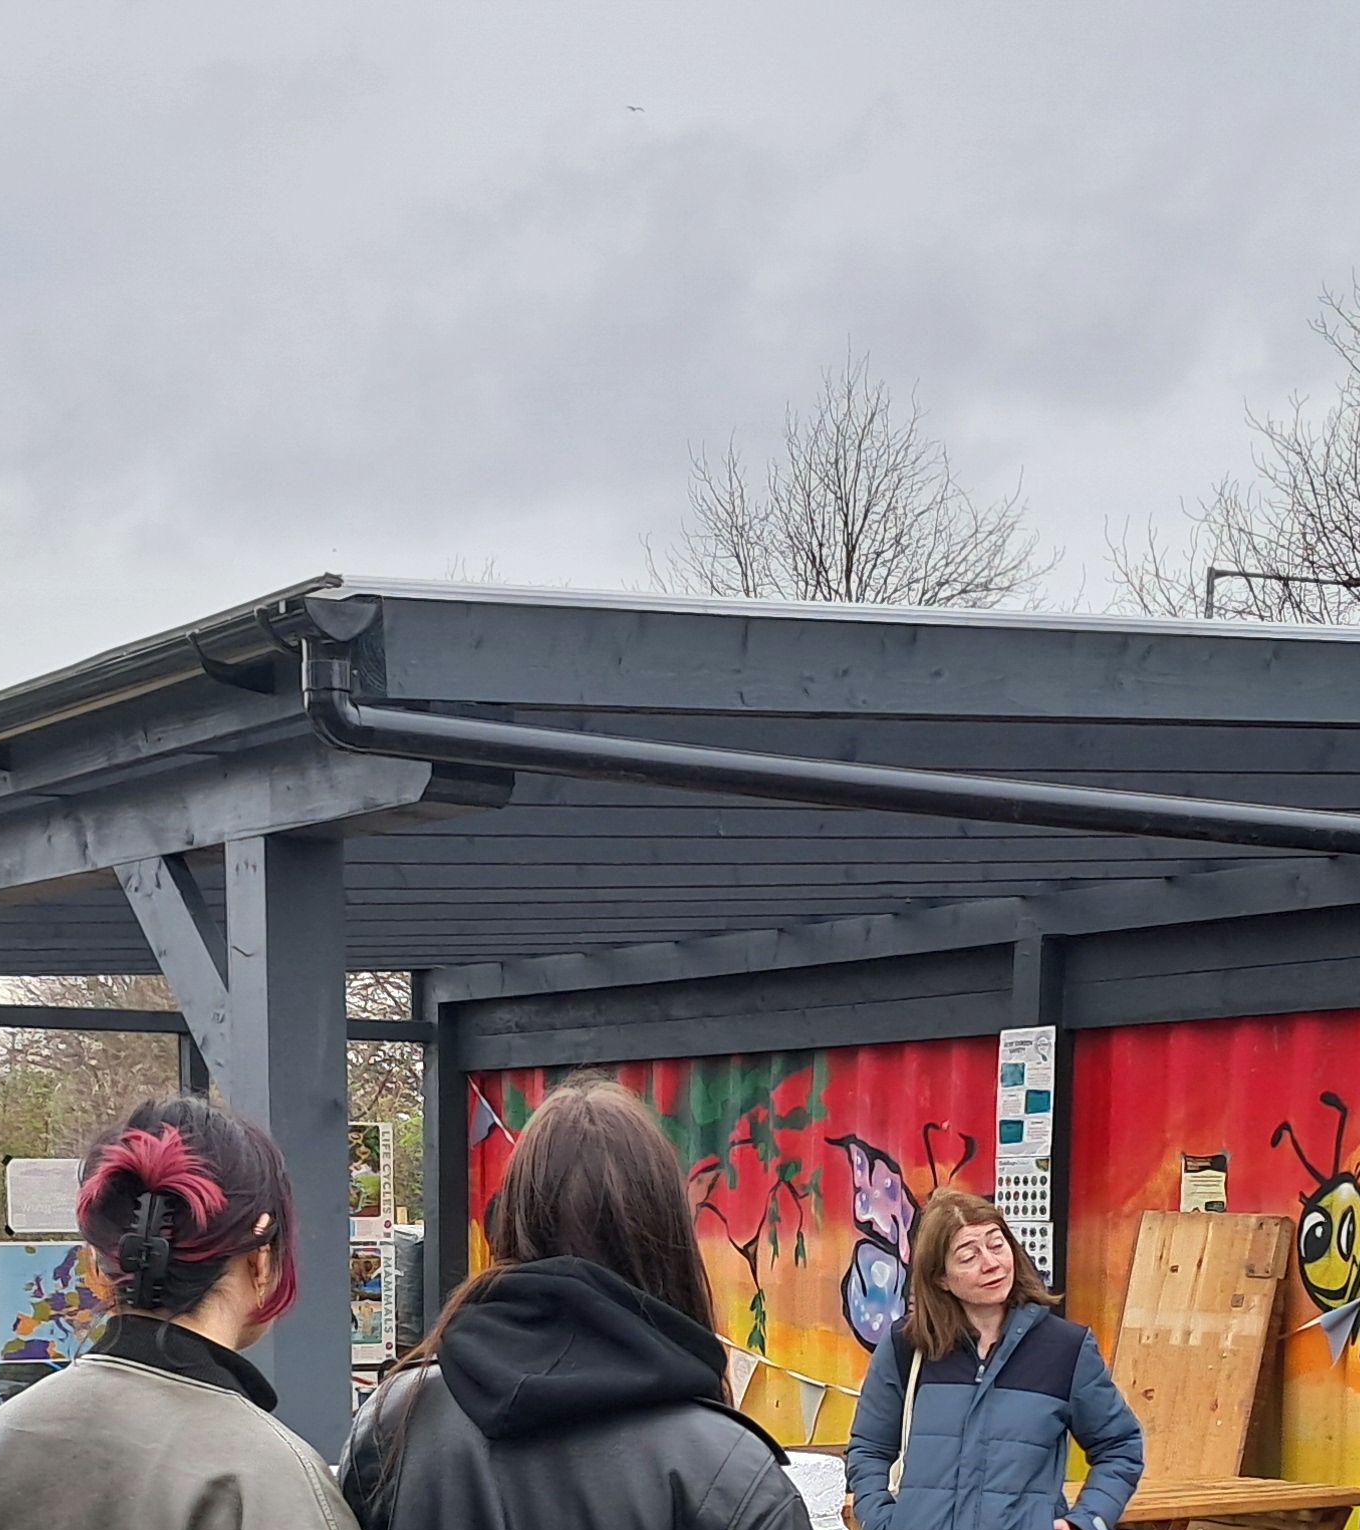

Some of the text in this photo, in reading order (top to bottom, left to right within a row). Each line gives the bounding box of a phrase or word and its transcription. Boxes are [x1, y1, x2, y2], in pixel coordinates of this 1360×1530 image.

[382, 1131, 392, 1214] LIFE CYCLES
[383, 1256, 393, 1334] MAMMALS
